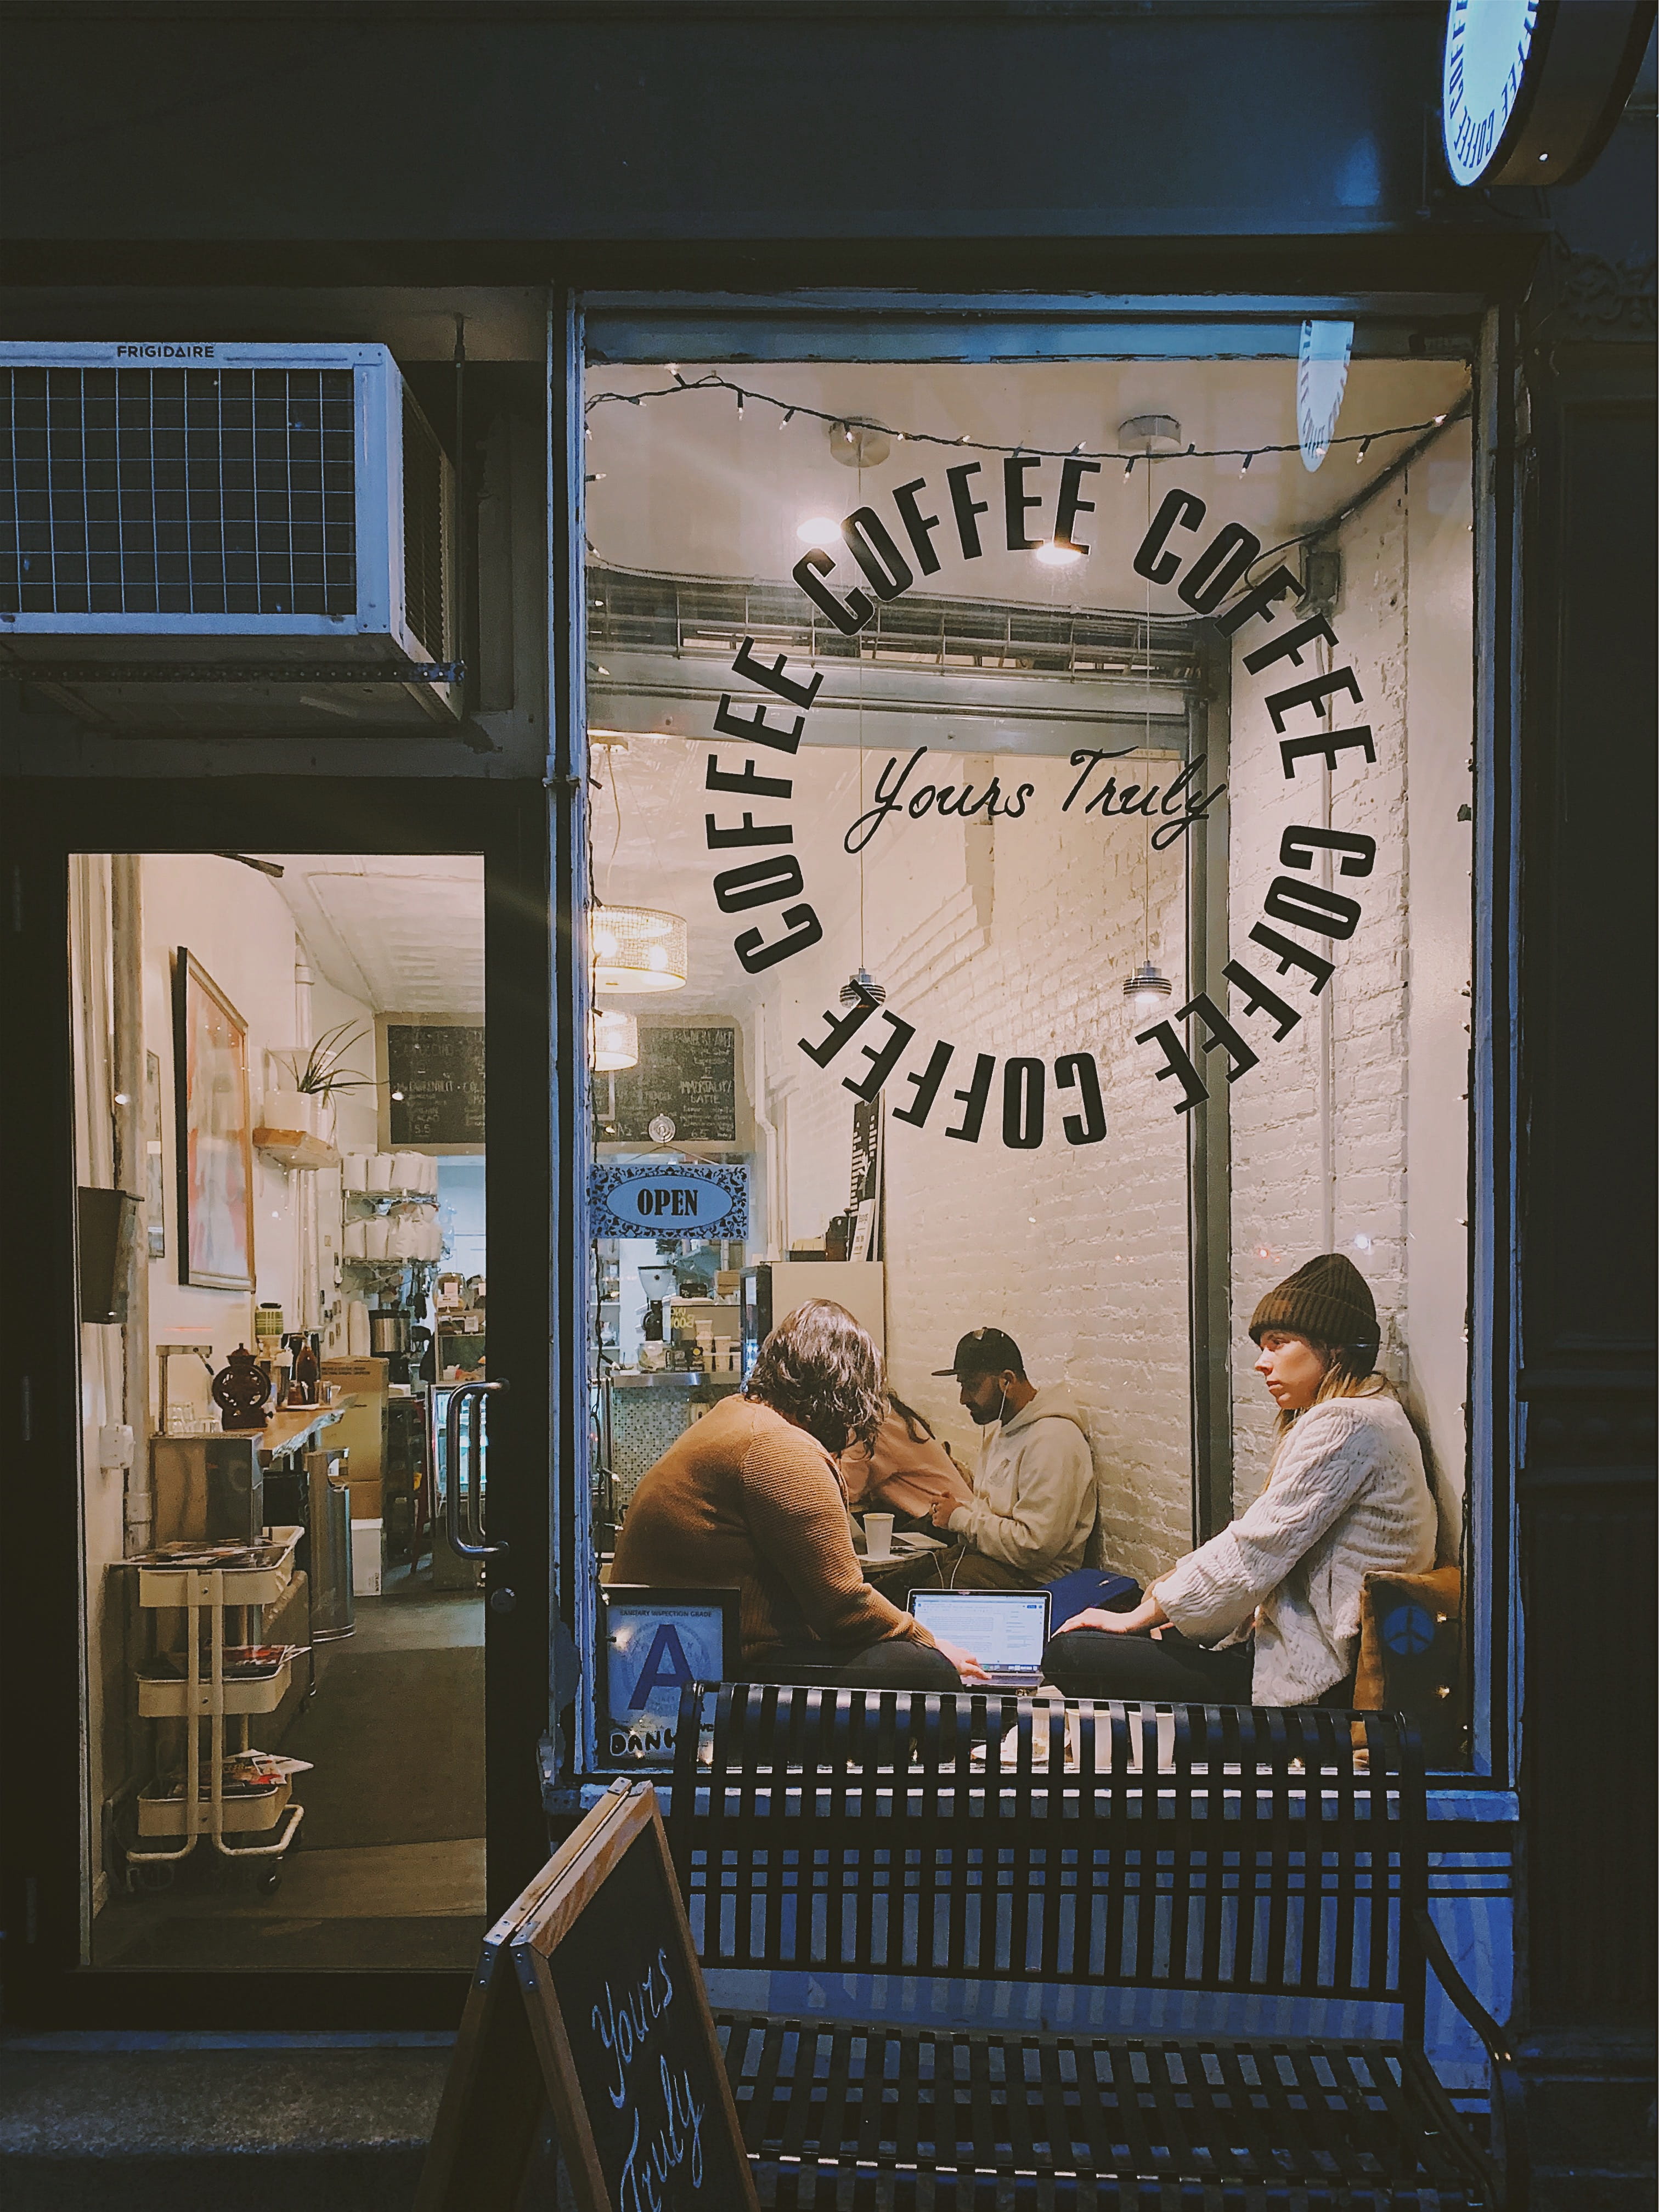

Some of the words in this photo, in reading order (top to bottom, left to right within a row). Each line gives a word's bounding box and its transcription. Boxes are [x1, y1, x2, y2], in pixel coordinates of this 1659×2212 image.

[117, 346, 215, 357] FRIGIDAIRE
[792, 456, 1102, 636] COFFEE
[1133, 488, 1376, 780] COFFEE
[705, 635, 824, 975] COFFEE
[843, 746, 1035, 855] Yours
[1060, 746, 1227, 851] Truly
[1135, 824, 1377, 1115] COFFEE
[797, 979, 1108, 1150] COFFEE
[637, 1188, 698, 1216] OPEN
[627, 1623, 706, 1712] A
[591, 1946, 673, 2109] Yours
[620, 2053, 705, 2212] Truly
